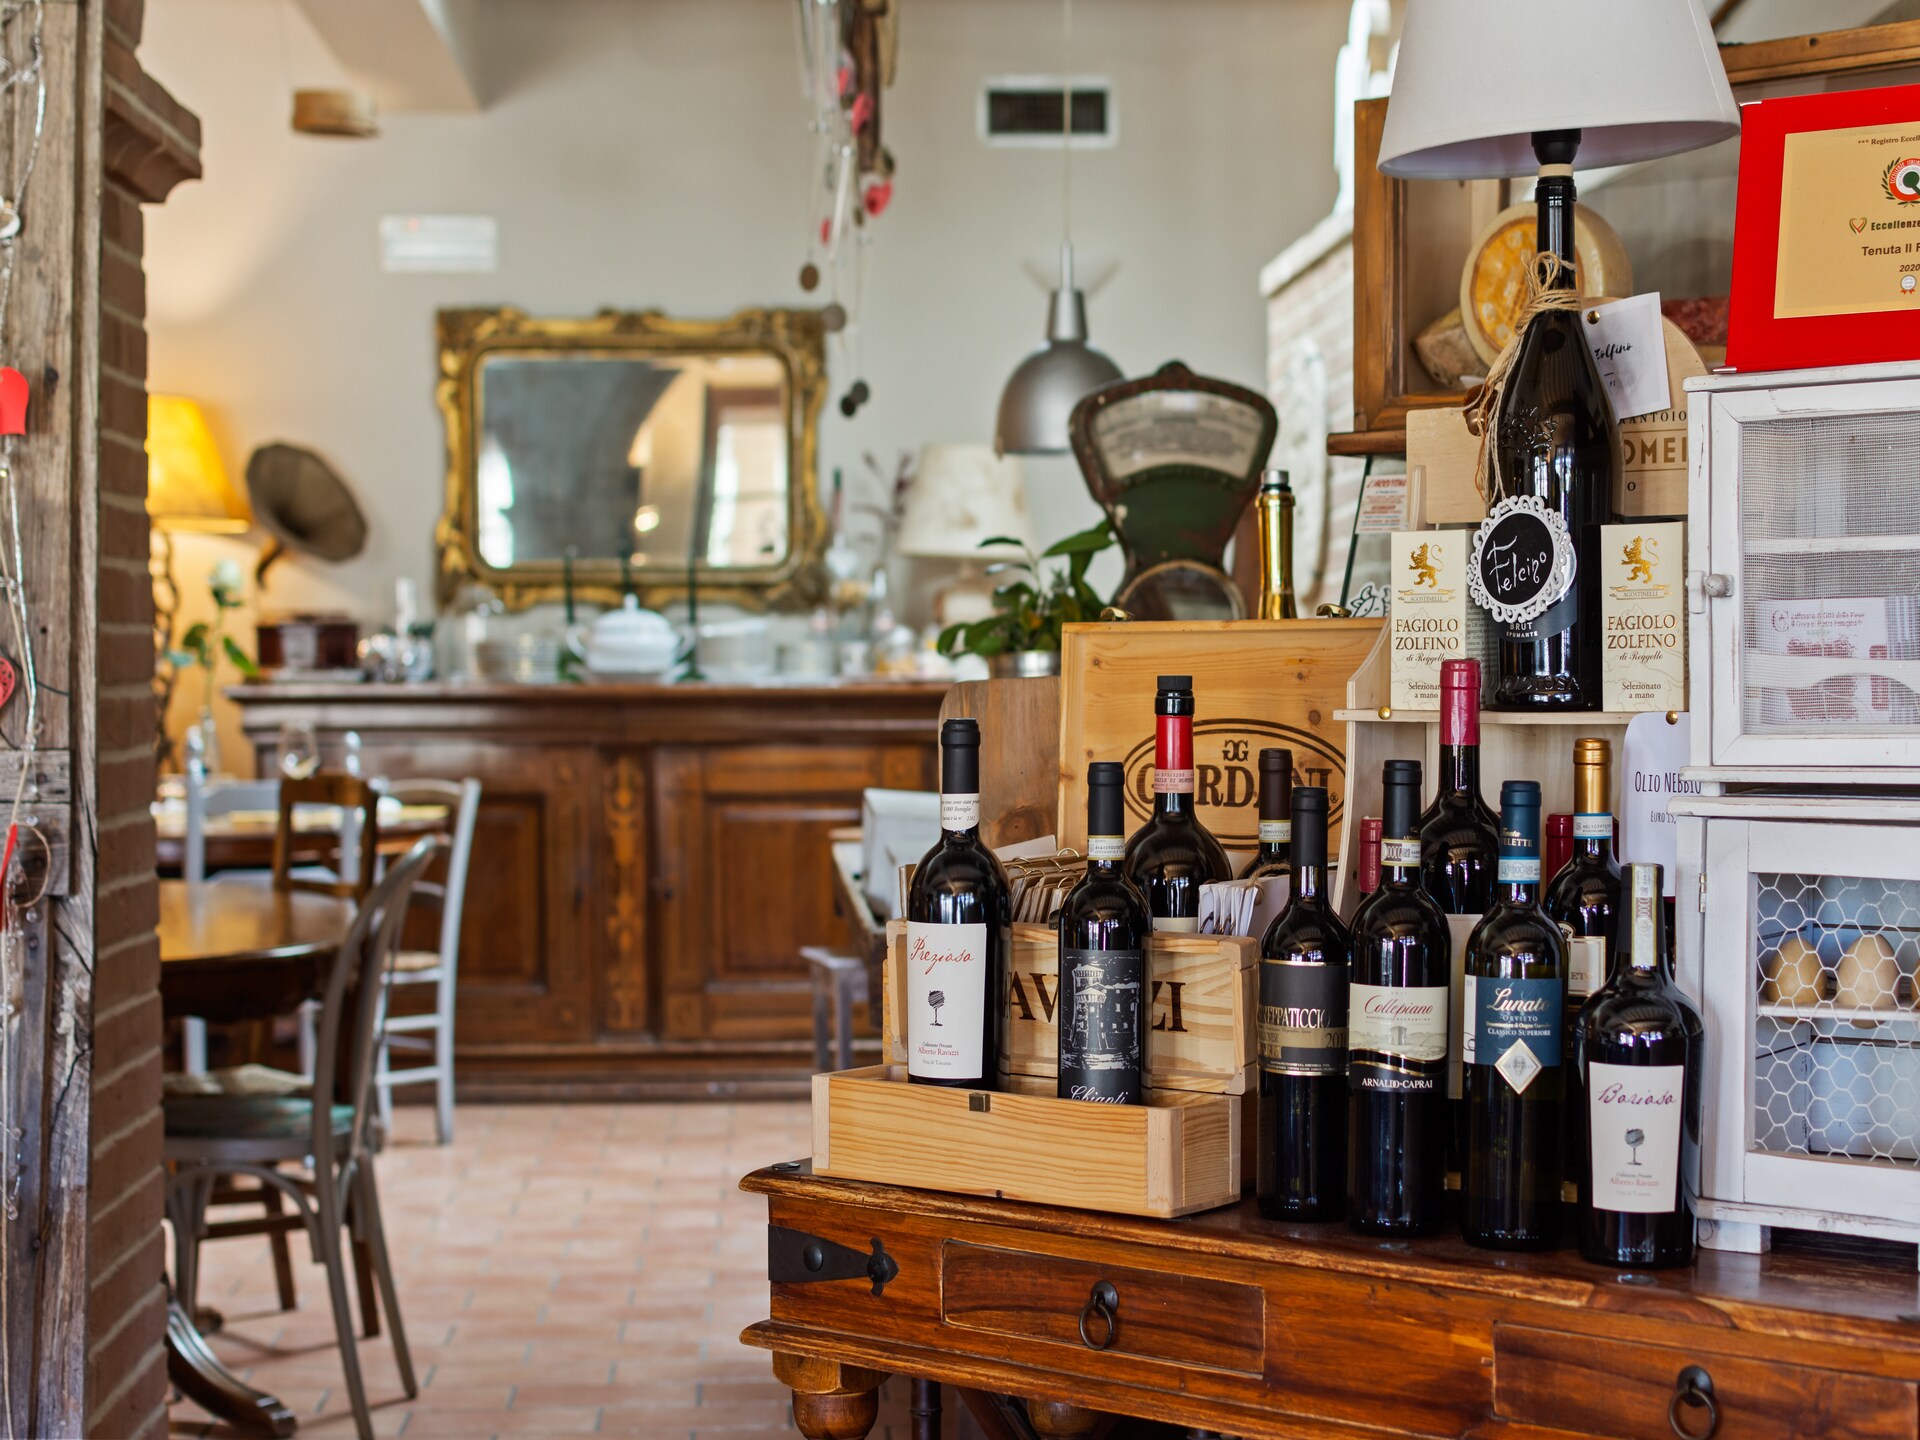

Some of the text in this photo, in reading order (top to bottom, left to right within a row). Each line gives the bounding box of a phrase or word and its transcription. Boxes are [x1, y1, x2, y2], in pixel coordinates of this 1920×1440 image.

[1871, 137, 1899, 146] Registro
[1862, 245, 1901, 257] Tenuta
[1899, 264, 1920, 272] 2020
[1395, 618, 1458, 632] FAGIOLO
[1509, 621, 1533, 630] BRUT
[1607, 614, 1677, 631] FAGIOLO
[1395, 636, 1459, 650] ZOLFINO
[1607, 633, 1677, 649] ZOLFINO
[1406, 653, 1413, 661] di
[1619, 652, 1627, 660] di
[1408, 682, 1441, 691] Selezionat
[1621, 681, 1662, 690] Selezionato
[1634, 771, 1661, 793] OLIO
[1650, 811, 1666, 823] EURO
[1486, 986, 1551, 1012] Lunato
[1364, 994, 1434, 1021] Collepiano
[1503, 1014, 1538, 1022] ORVIETO
[1487, 1027, 1551, 1036] CLASSICO SUPERIORE
[937, 1048, 960, 1056] Ravazzi
[1071, 1084, 1129, 1104] Chianti
